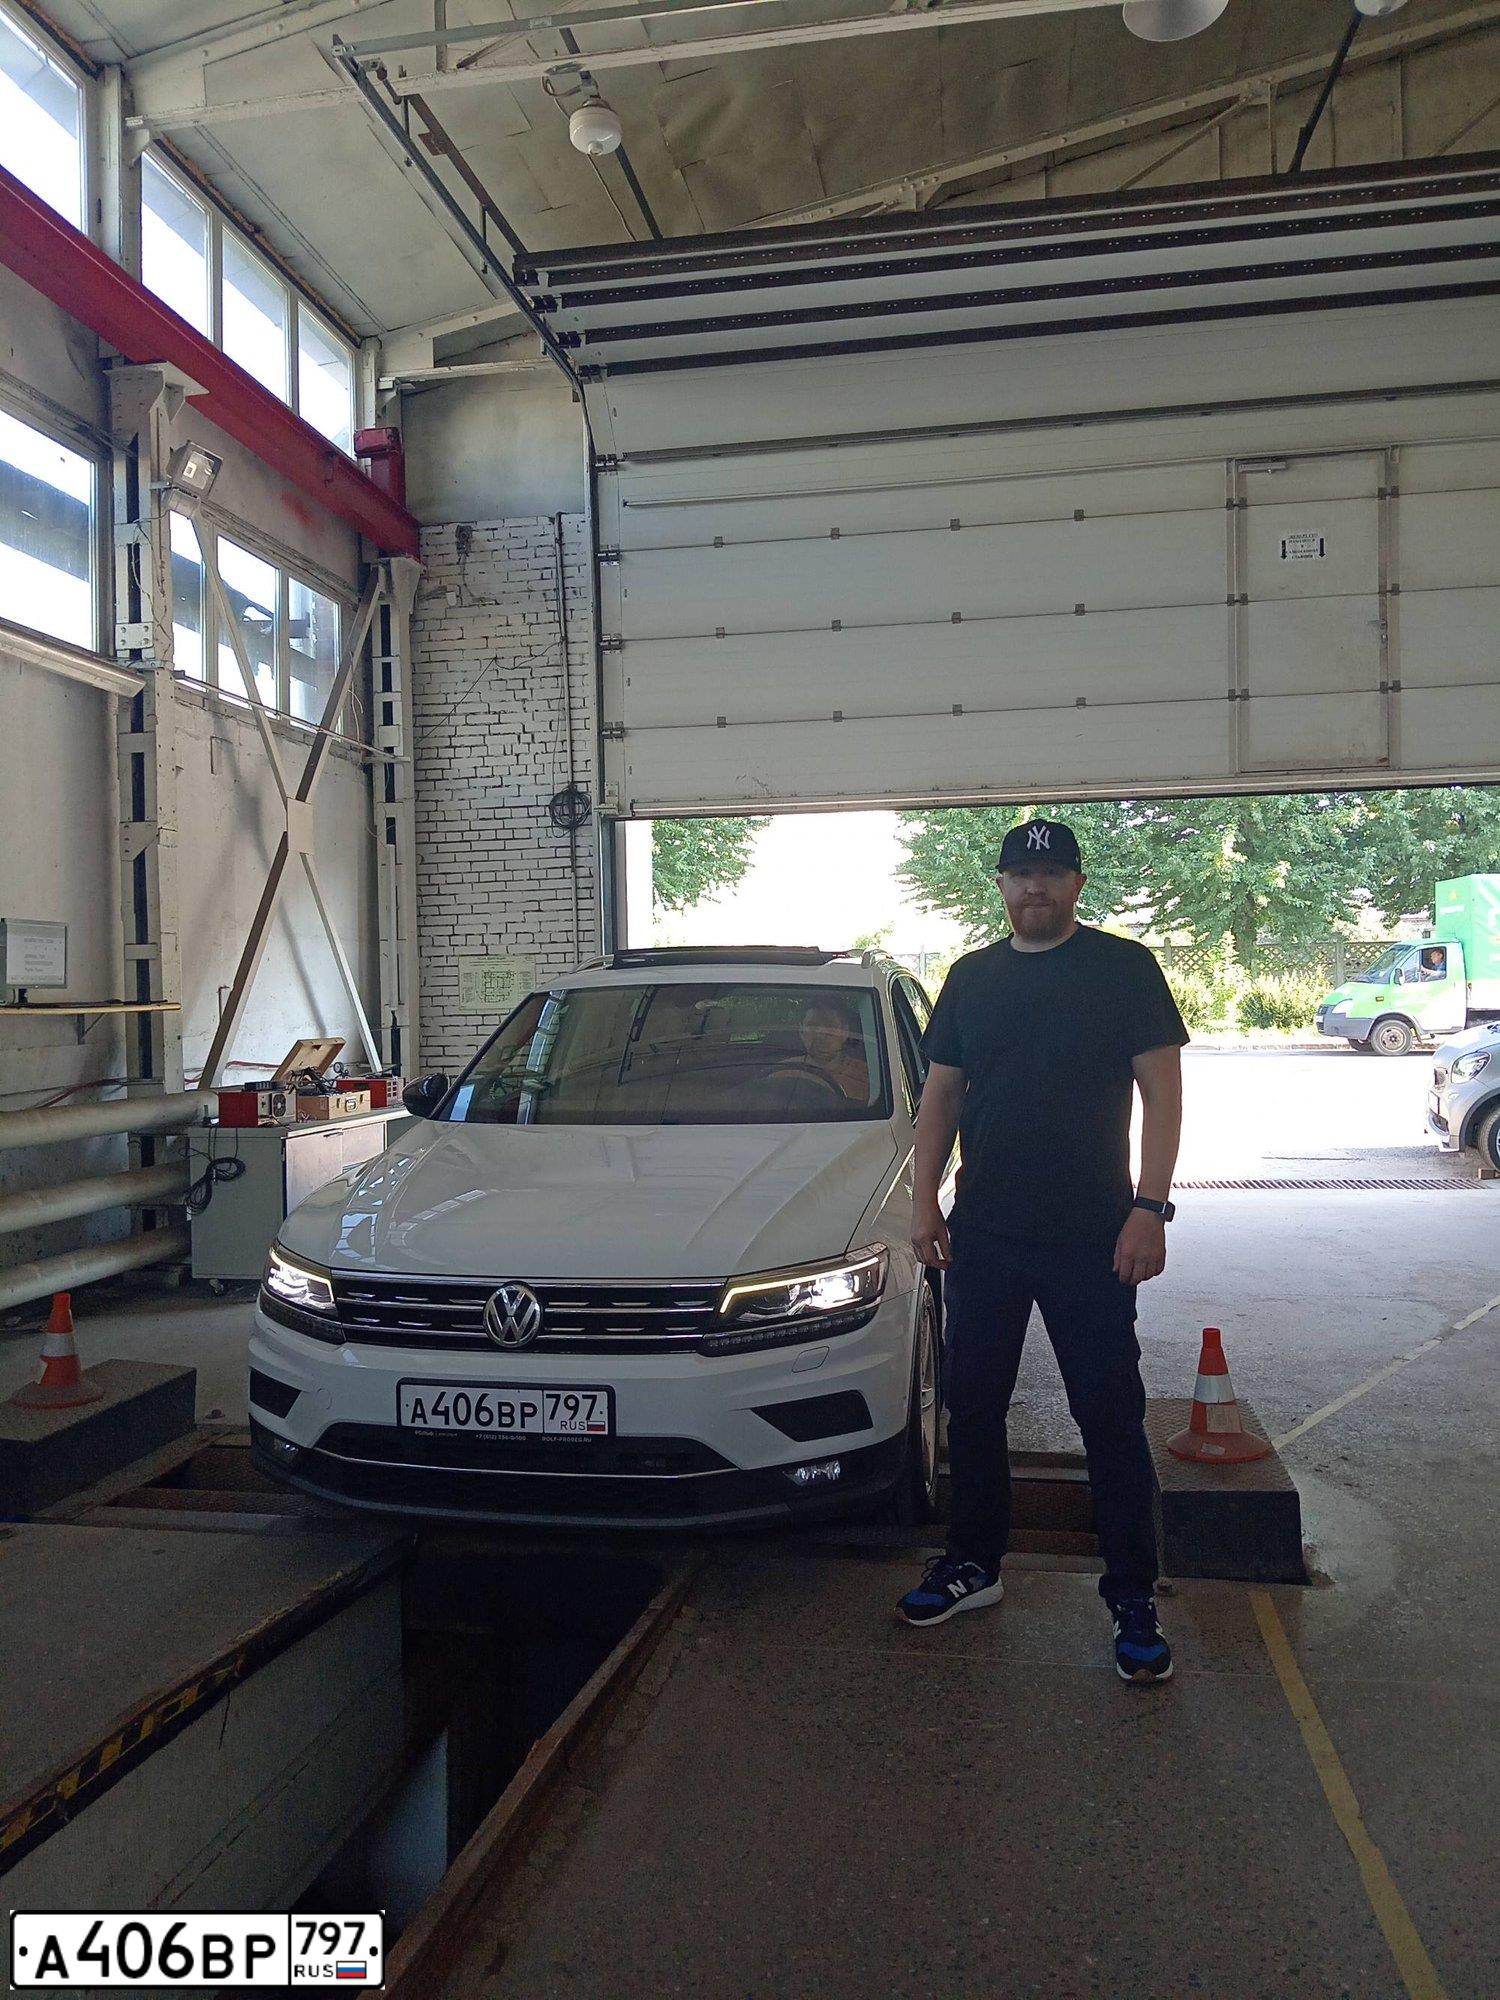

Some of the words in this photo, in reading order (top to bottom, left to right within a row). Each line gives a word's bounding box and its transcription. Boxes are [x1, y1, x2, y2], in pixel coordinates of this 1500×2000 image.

[1026, 825, 1051, 851] NY
[410, 1391, 538, 1429] А406ВР
[546, 1394, 597, 1421] 797
[560, 1420, 586, 1431] RUS
[947, 1579, 968, 1598] N
